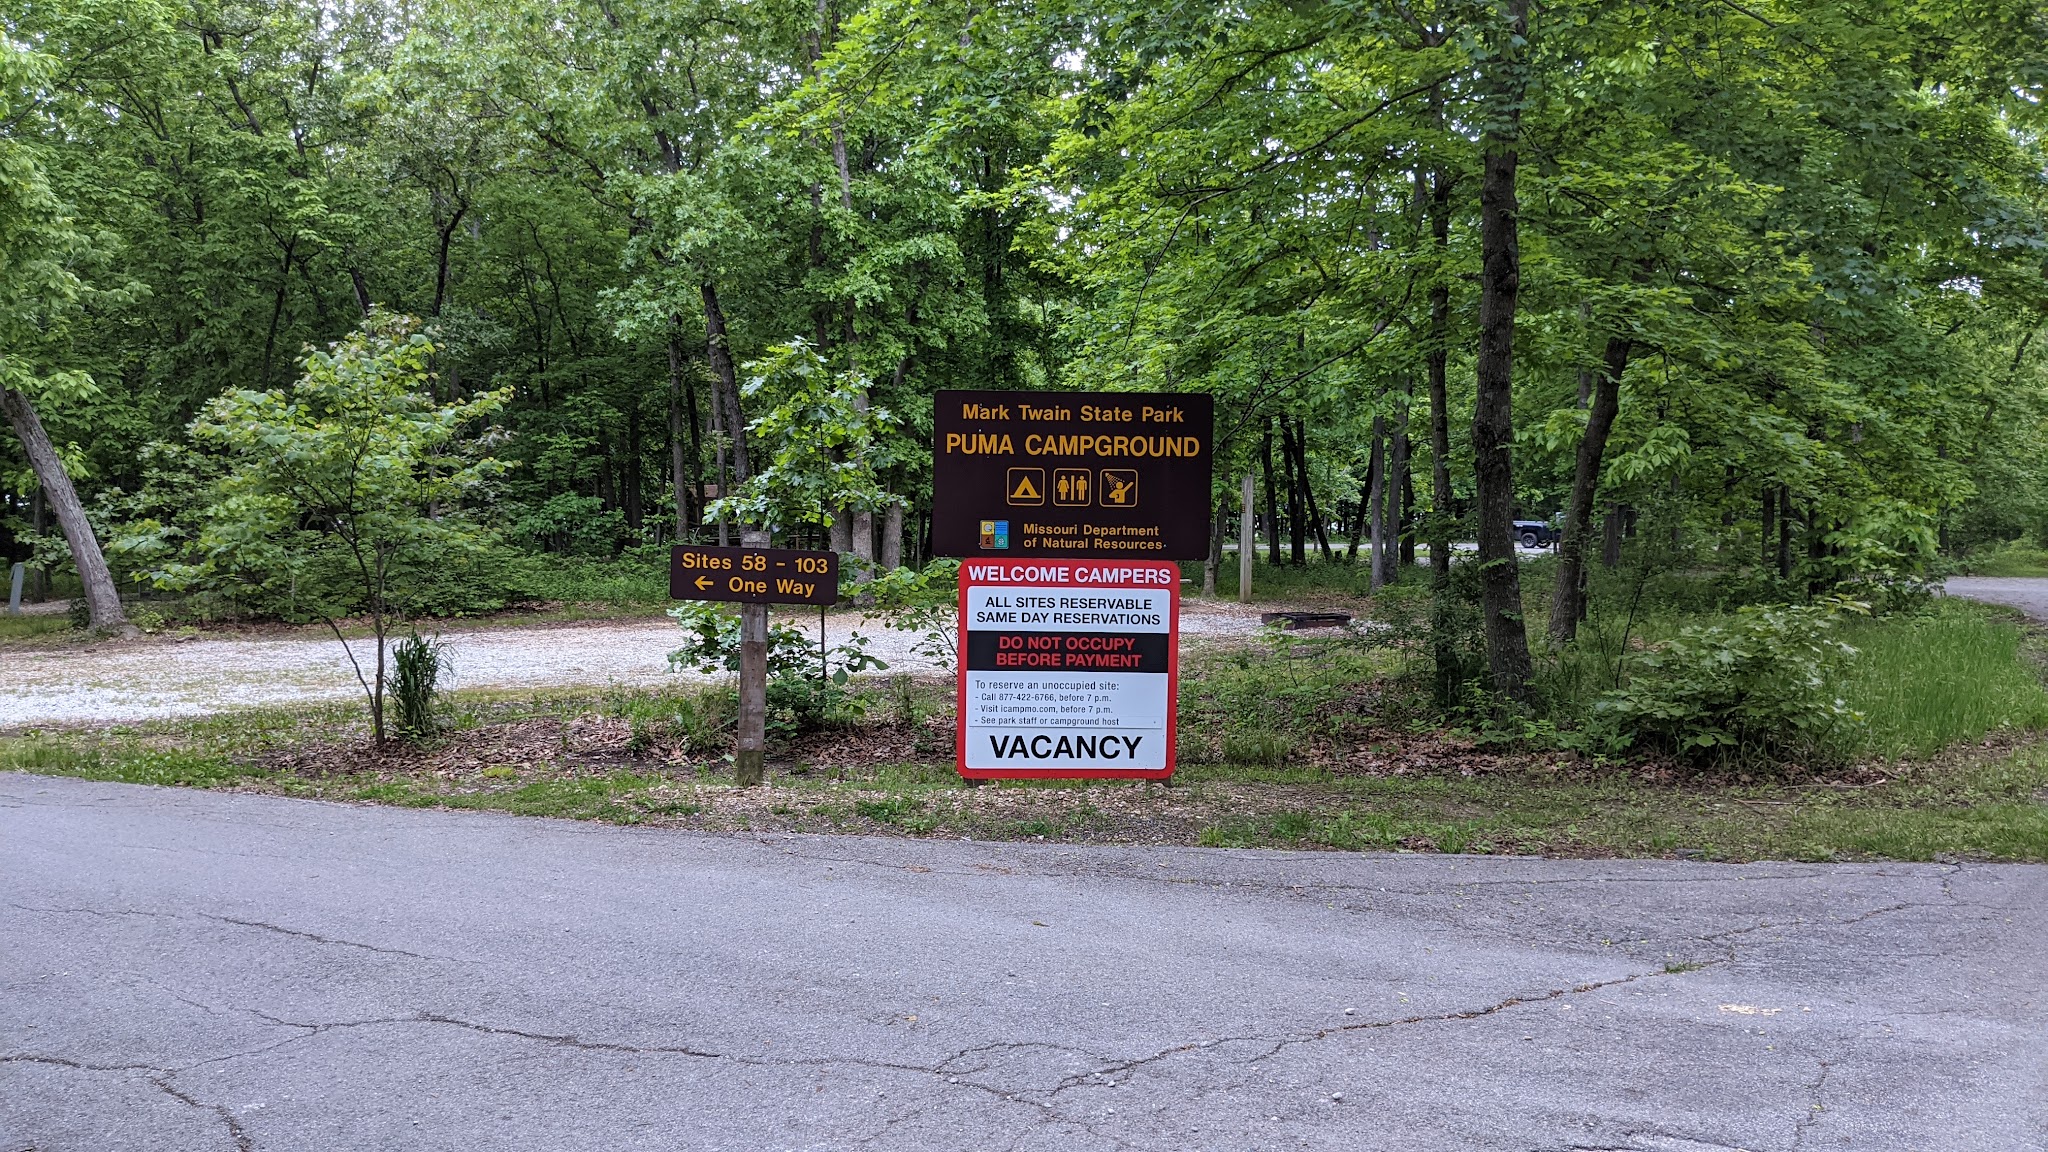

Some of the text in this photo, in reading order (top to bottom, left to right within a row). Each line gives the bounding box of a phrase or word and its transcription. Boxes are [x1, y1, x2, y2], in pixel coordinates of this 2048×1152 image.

[963, 404, 1184, 423] Mark Twain State Park
[947, 433, 1200, 457] PUMA CAMPGROUND
[1024, 524, 1159, 538] Missouri Department
[1024, 538, 1163, 550] of Natural Resources
[682, 553, 732, 570] Sites
[742, 556, 767, 571] 58
[795, 558, 828, 574] 103
[968, 566, 1171, 585] WELCOME CAMPERS
[729, 577, 815, 598] One Way
[985, 597, 1152, 610] ALL SITES RESERVABLE
[977, 612, 1161, 625] SAME DAY RESERVATIONS
[1000, 637, 1136, 651] DO NOT OCCUPY
[997, 653, 1142, 667] BEFORE PAYMENT
[976, 680, 1120, 692] To reserve an unoccupied site:
[981, 693, 997, 701] Call
[999, 694, 1057, 702] 877-422-6766,
[1059, 694, 1084, 702] before
[1087, 694, 1092, 702] 7
[1094, 696, 1111, 704] p.m.
[981, 705, 998, 713] Visit
[1001, 705, 1058, 716] icampmo.com,
[1096, 707, 1113, 716] p.m.
[999, 717, 1016, 726] park
[1019, 717, 1037, 725] staff
[1050, 717, 1100, 727] campground
[1102, 717, 1119, 726] host
[990, 735, 1143, 759] VACANCY
